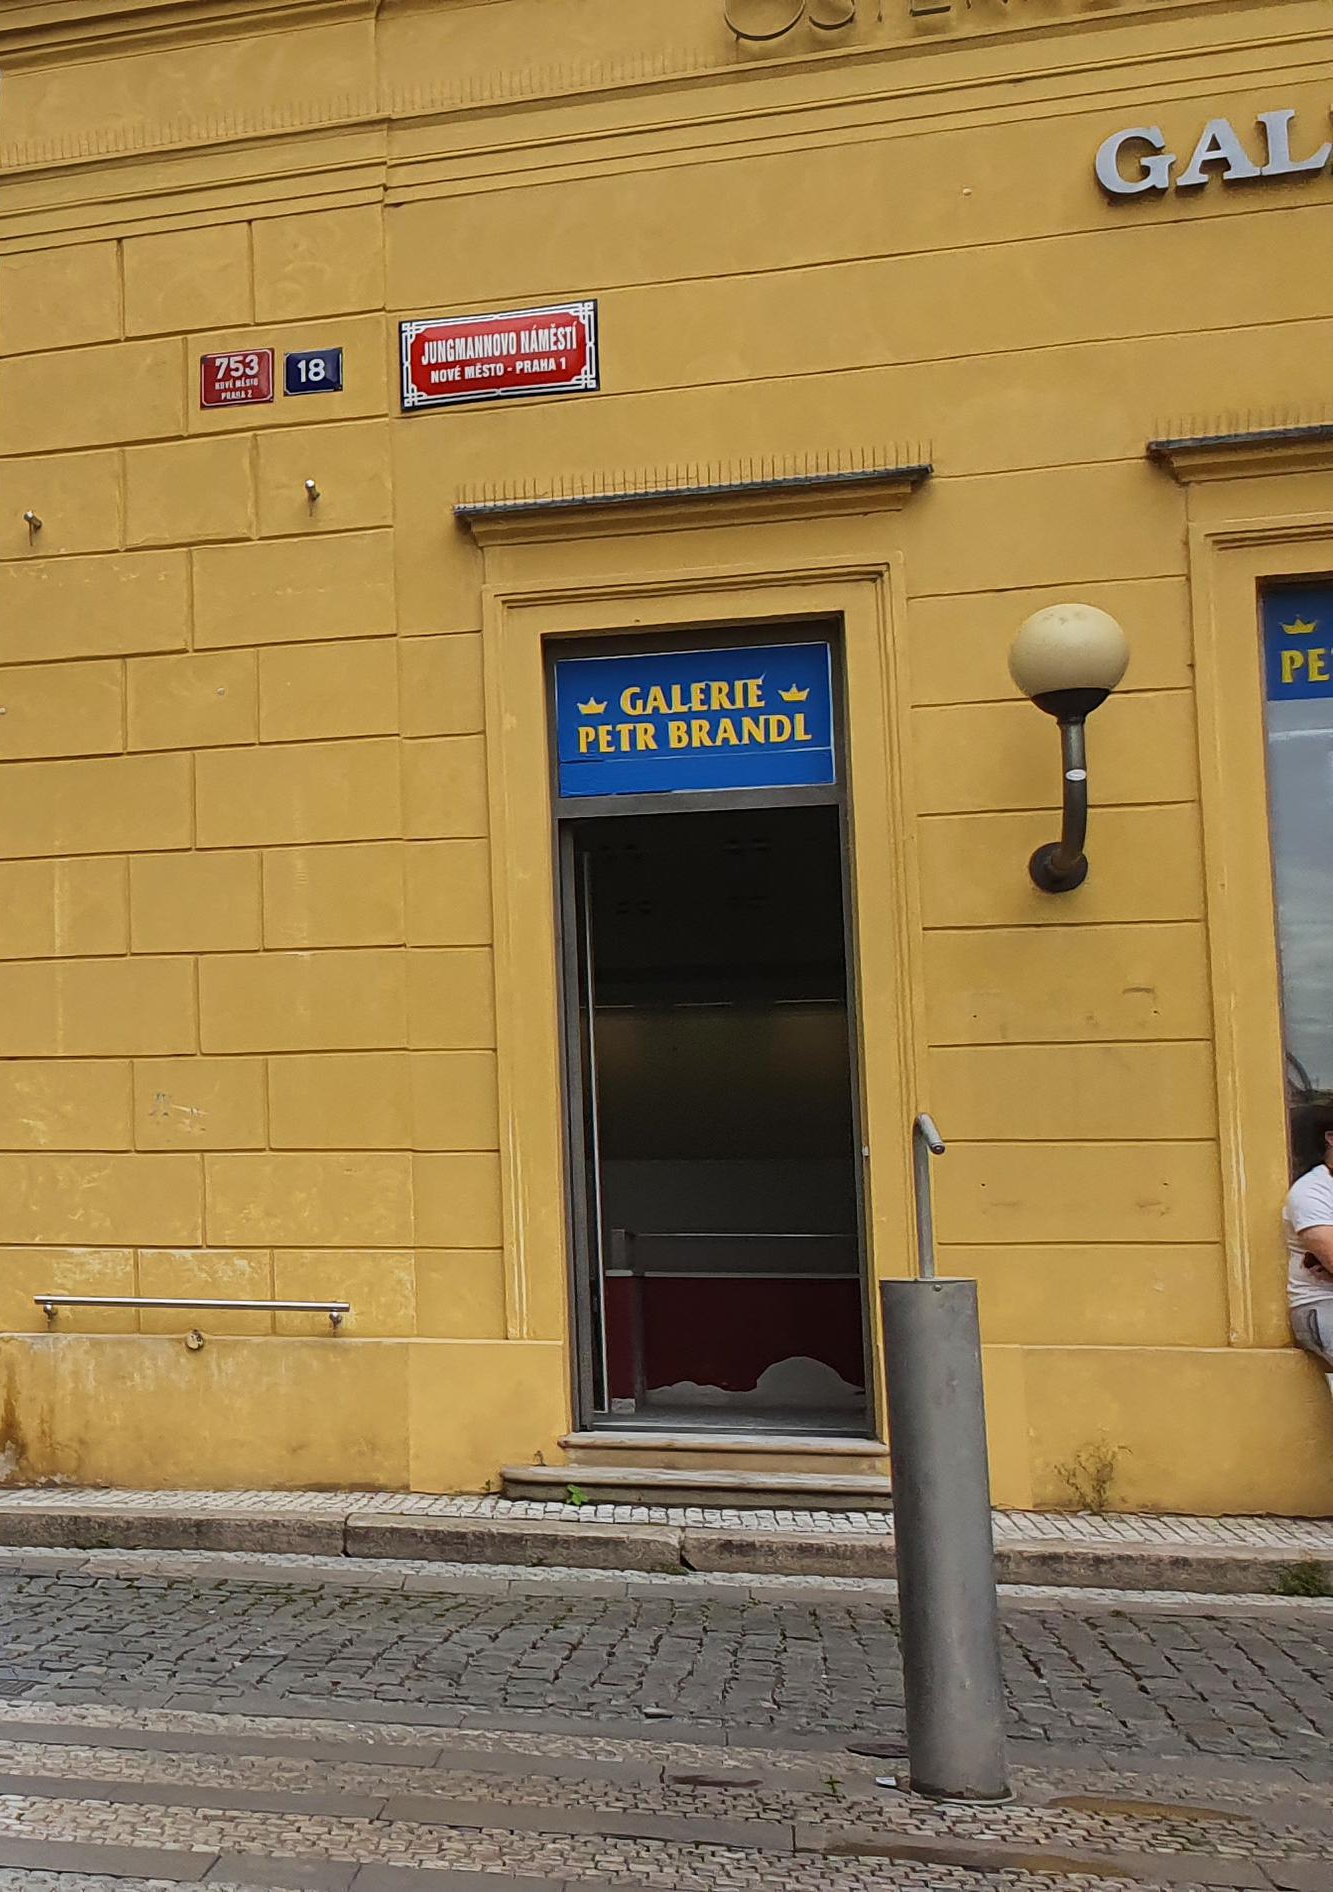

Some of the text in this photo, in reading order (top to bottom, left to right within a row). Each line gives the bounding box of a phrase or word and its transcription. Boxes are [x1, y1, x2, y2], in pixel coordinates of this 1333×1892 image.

[1095, 109, 1333, 194] GAL
[421, 321, 578, 366] JUNGMANNOVO NÁMĚSTÍ
[214, 354, 260, 380] 753
[297, 358, 326, 383] 18
[430, 365, 462, 384] NOVÉ
[464, 363, 504, 380] MĚSTO
[515, 358, 557, 374] PRAHA
[559, 356, 567, 370] 1
[1280, 647, 1333, 684] PE
[620, 676, 766, 716] GALERIE
[578, 713, 813, 753] PETR BRANDL
